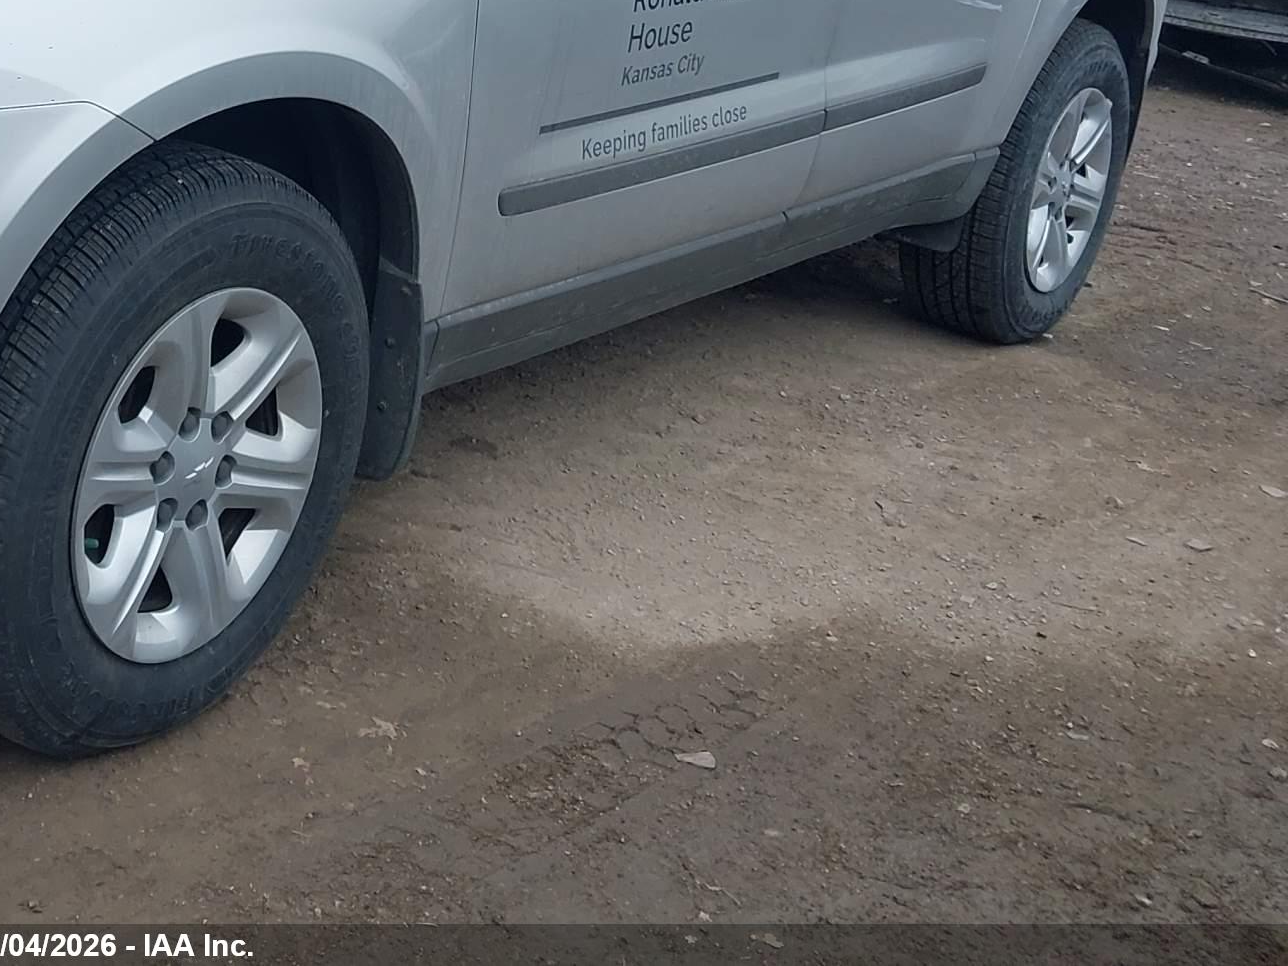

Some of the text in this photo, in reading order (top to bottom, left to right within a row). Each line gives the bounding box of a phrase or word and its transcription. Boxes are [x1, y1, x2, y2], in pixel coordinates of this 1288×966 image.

[627, 18, 693, 53] House
[621, 53, 705, 87] Kansas City
[581, 104, 747, 160] Keeping families close
